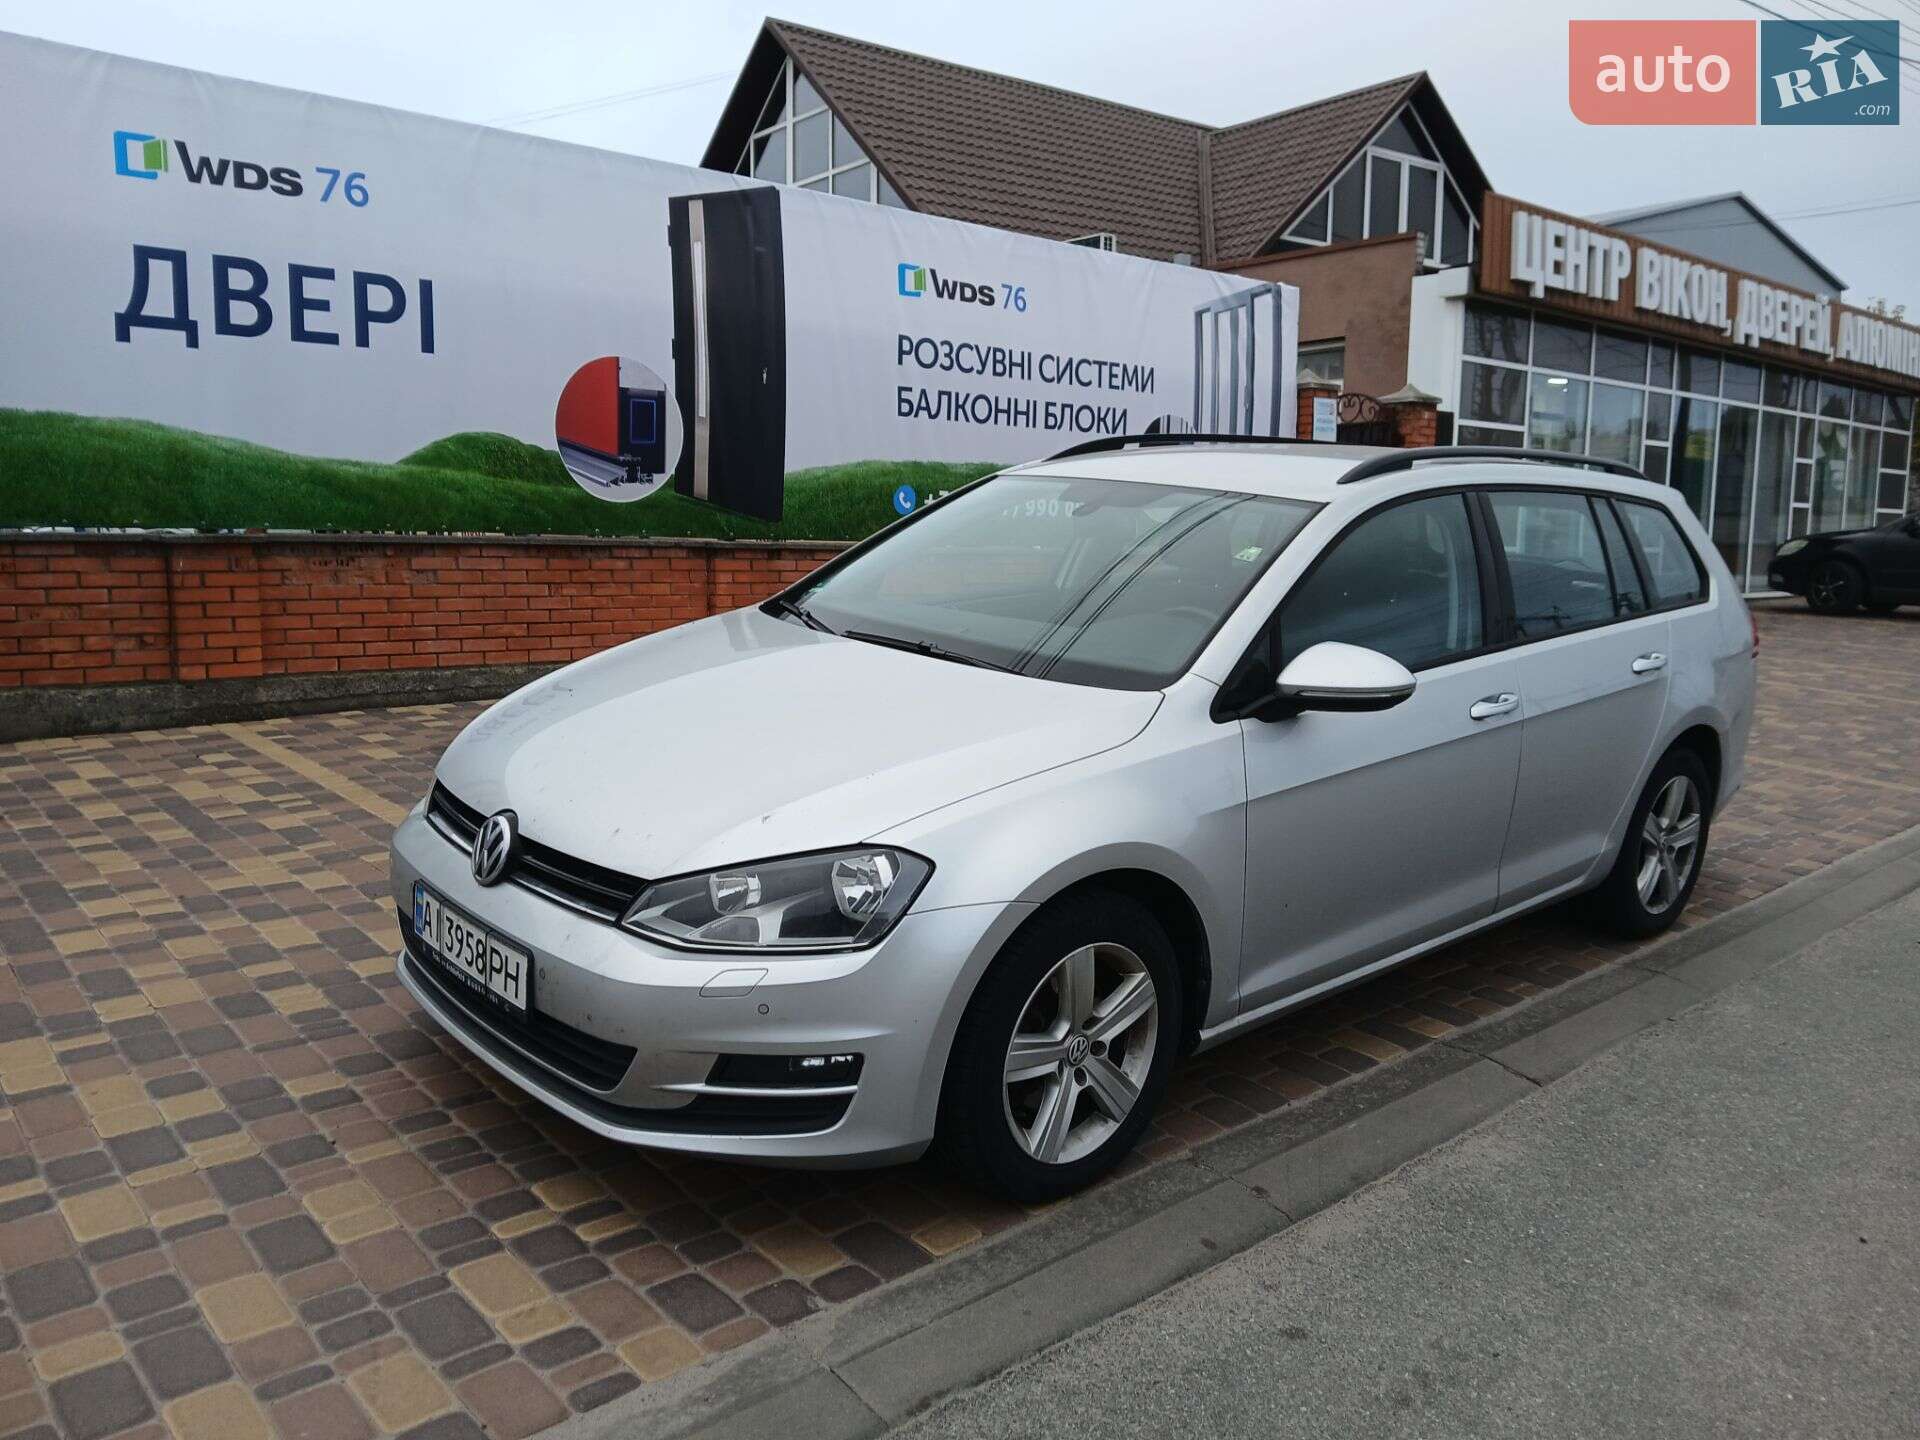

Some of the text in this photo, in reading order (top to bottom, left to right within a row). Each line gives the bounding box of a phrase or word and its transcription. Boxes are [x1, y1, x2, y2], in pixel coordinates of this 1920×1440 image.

[174, 139, 369, 207] WDS 76
[114, 244, 435, 354] ДВЕРІ
[929, 268, 1028, 312] WDS 76
[1510, 210, 1632, 301] ЦЕНТР
[1635, 246, 1732, 337] ВІКОН,
[1733, 278, 1835, 362] ДВЕРЕЙ,
[897, 333, 1155, 394] РОЗСУВНІ СИСТЕМИ
[897, 386, 1128, 435] БАЛКОННІ БЛОКИ
